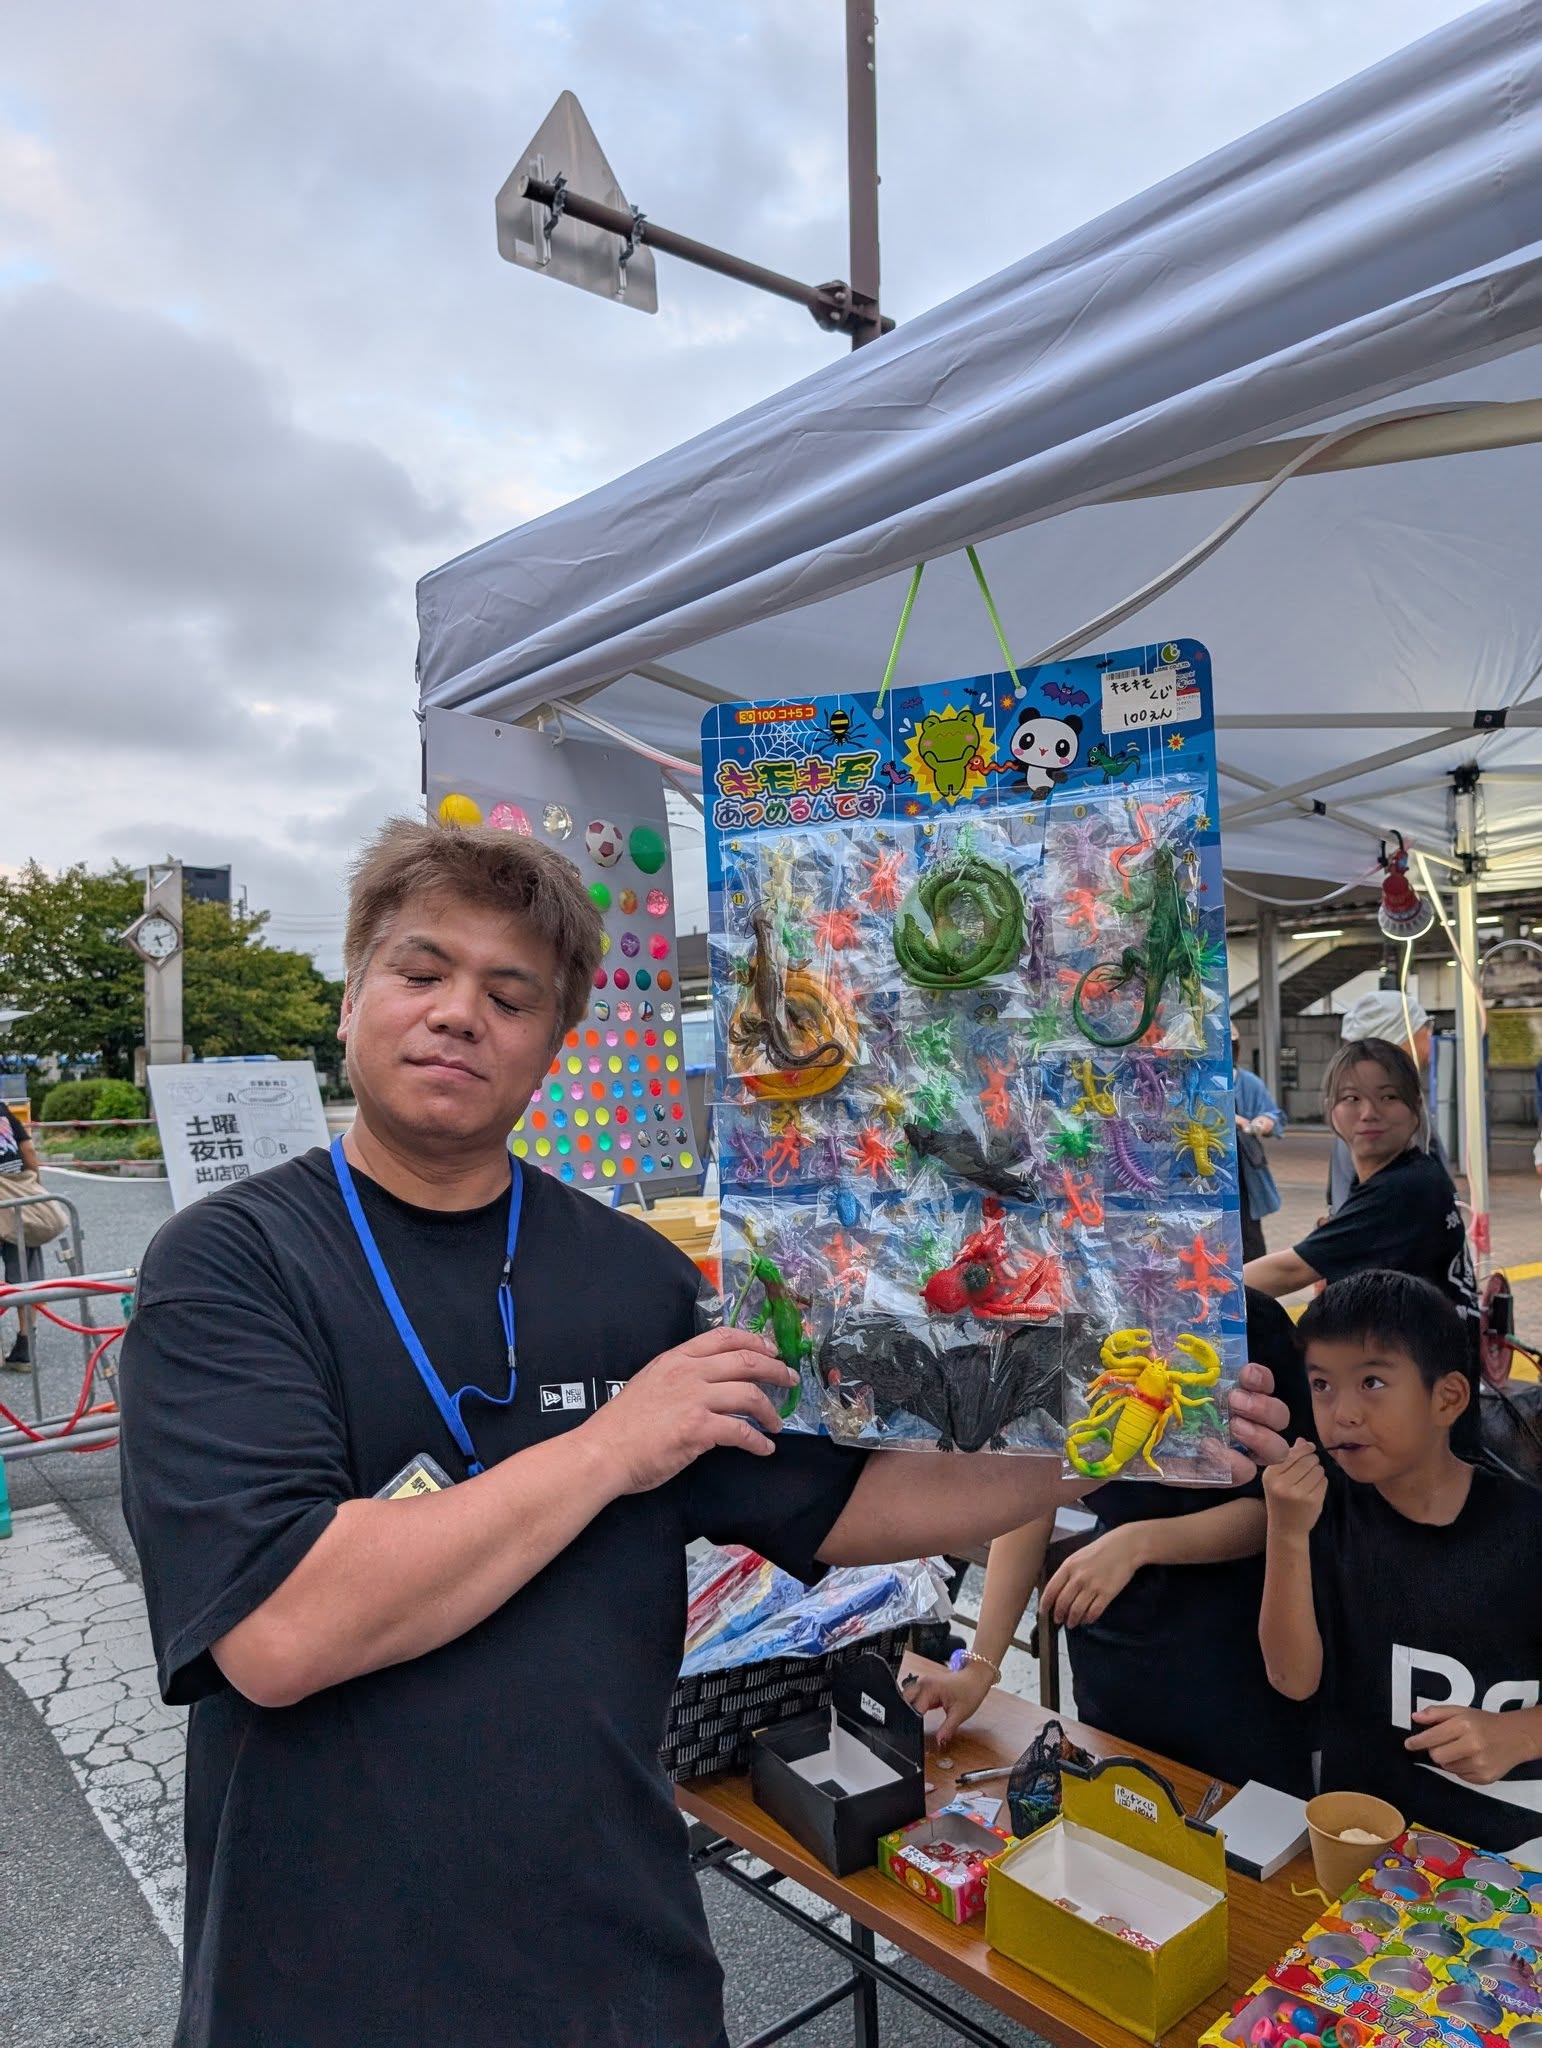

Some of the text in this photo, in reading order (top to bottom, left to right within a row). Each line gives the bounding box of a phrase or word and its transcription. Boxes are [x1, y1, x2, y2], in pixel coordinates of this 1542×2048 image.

[1110, 678, 1153, 695] キモキモ
[1149, 685, 1173, 700] くじ
[1123, 707, 1172, 726] 100えん
[719, 752, 877, 799] キモキモ
[716, 791, 882, 827] あつめるんです
[227, 1092, 237, 1104] A
[186, 1114, 240, 1137] 土曜
[188, 1138, 244, 1163] 夜市
[278, 1143, 288, 1154] B
[196, 1164, 249, 1184] 出店図
[565, 1388, 582, 1396] NEW
[566, 1396, 582, 1404] ERA
